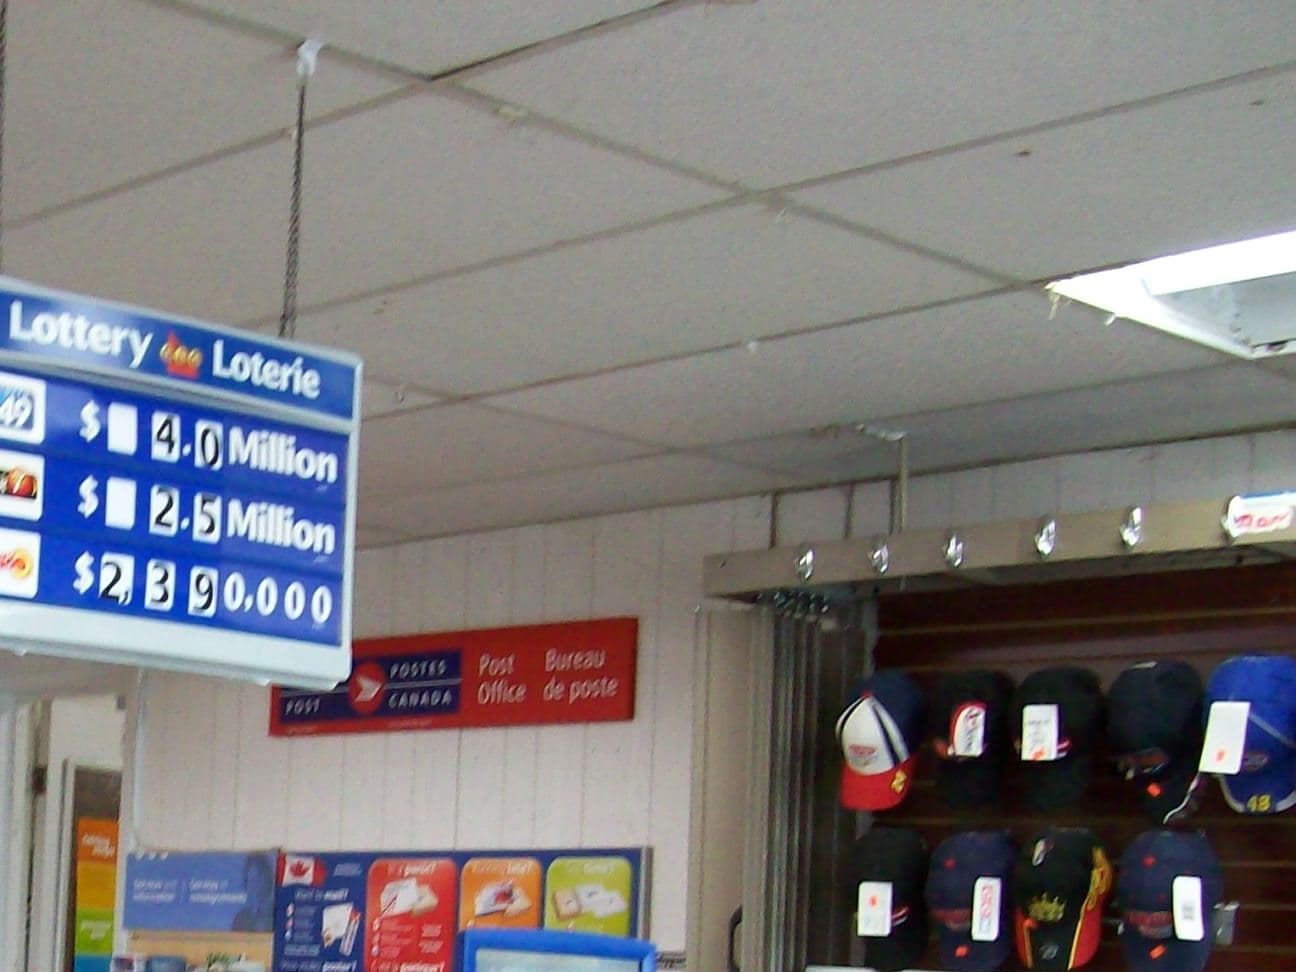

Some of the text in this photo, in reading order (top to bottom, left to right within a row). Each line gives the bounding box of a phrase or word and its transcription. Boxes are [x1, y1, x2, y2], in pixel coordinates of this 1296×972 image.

[10, 301, 321, 399] Lottery Loterie
[229, 426, 338, 484] Million
[227, 500, 335, 555] Million
[389, 659, 448, 680] POSTES
[478, 648, 606, 676] Post Bureau
[388, 688, 453, 710] CANADA
[477, 675, 619, 706] Office de poste
